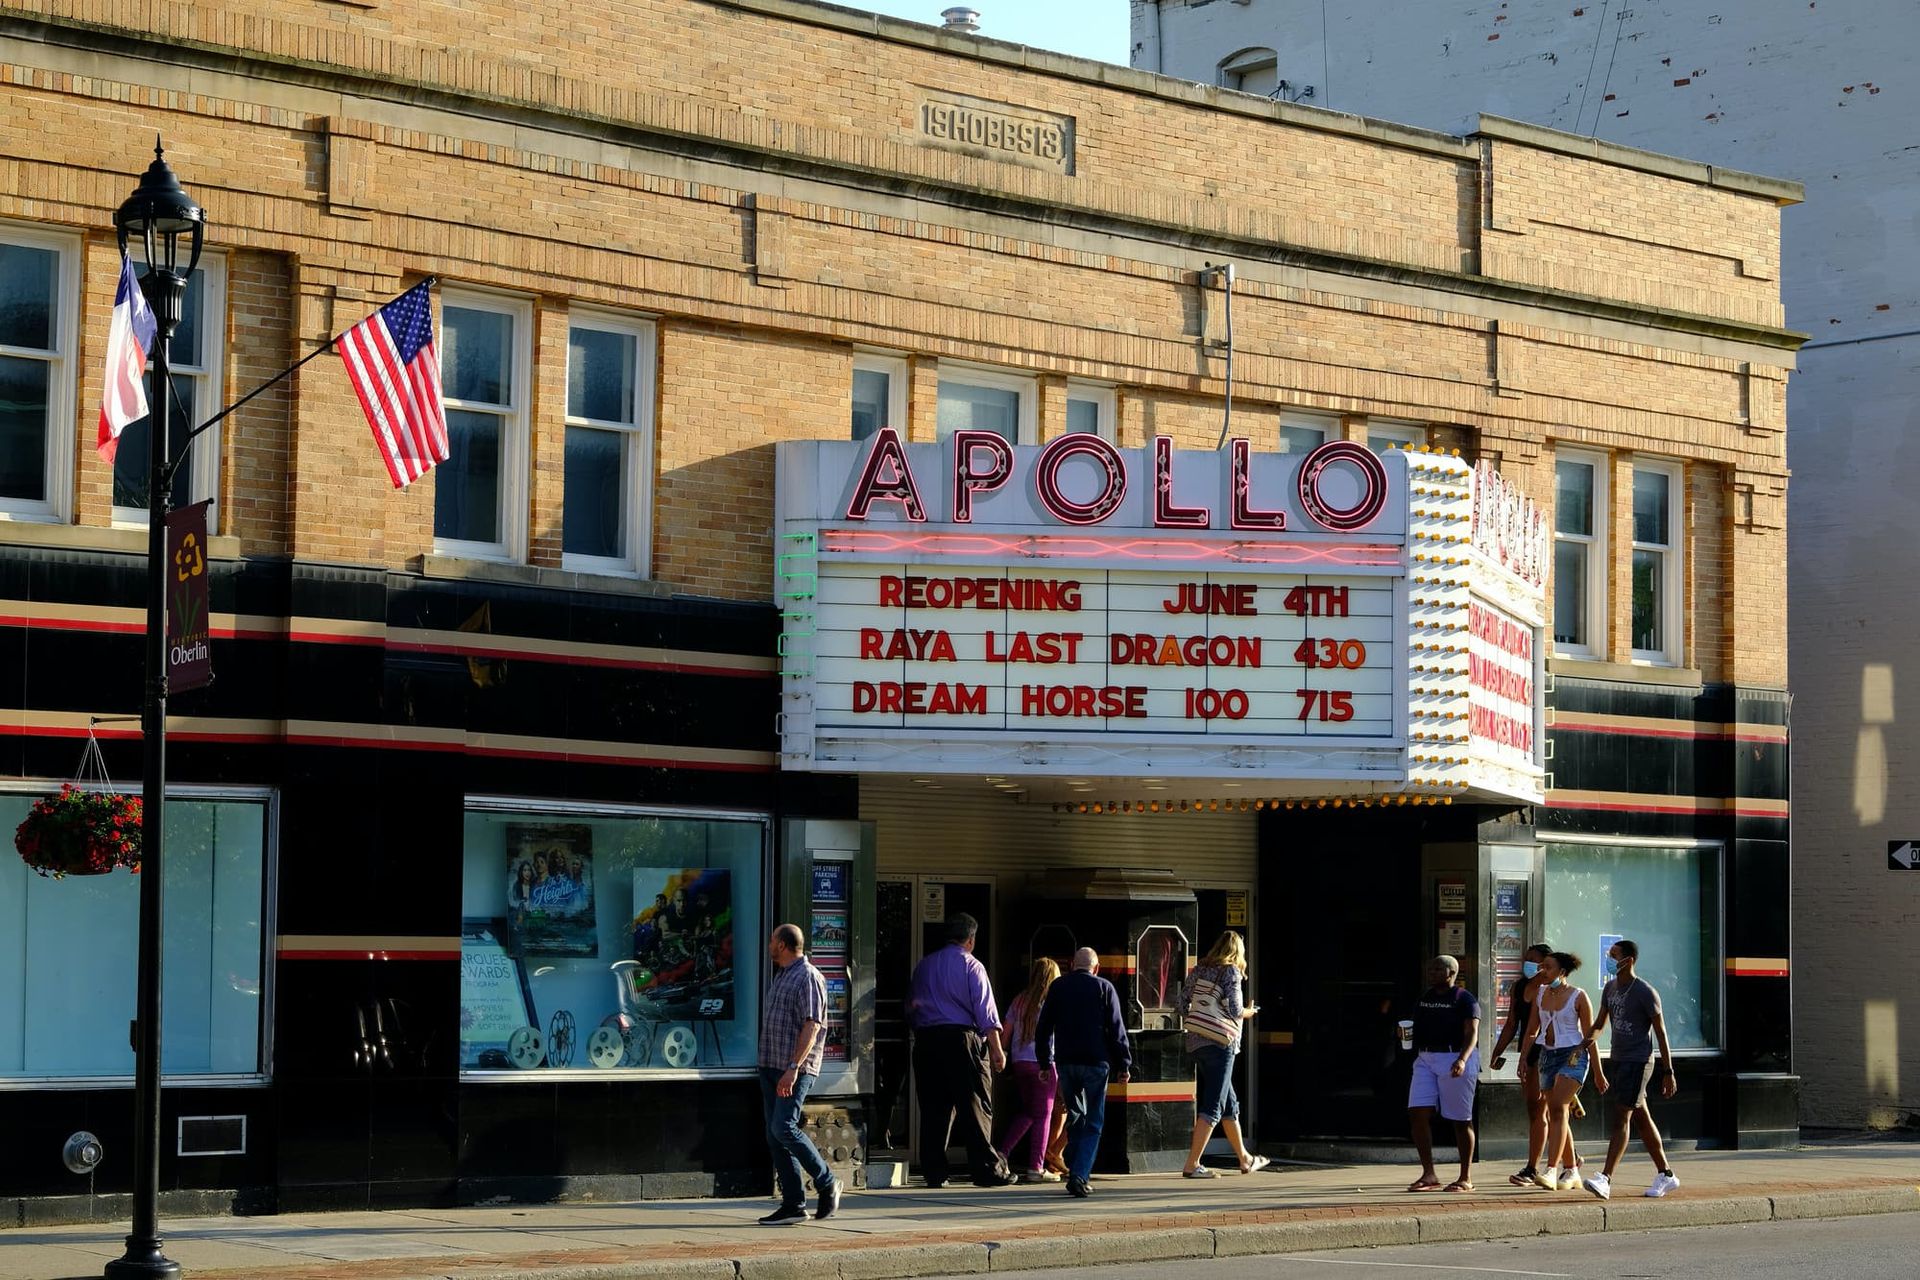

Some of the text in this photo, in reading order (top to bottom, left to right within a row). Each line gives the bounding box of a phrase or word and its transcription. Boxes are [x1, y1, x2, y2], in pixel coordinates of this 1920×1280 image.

[846, 427, 1389, 531] APOLLO
[879, 575, 1349, 617] REOPENING JUNE 4TH
[170, 640, 208, 665] Oberlin
[860, 628, 1367, 669] RAYA LAST DRAGON 430
[853, 681, 1355, 722] DREAM HORSE 100 715
[533, 880, 579, 907] Heights
[462, 953, 508, 966] ARQUEE
[699, 998, 725, 1012] F9
